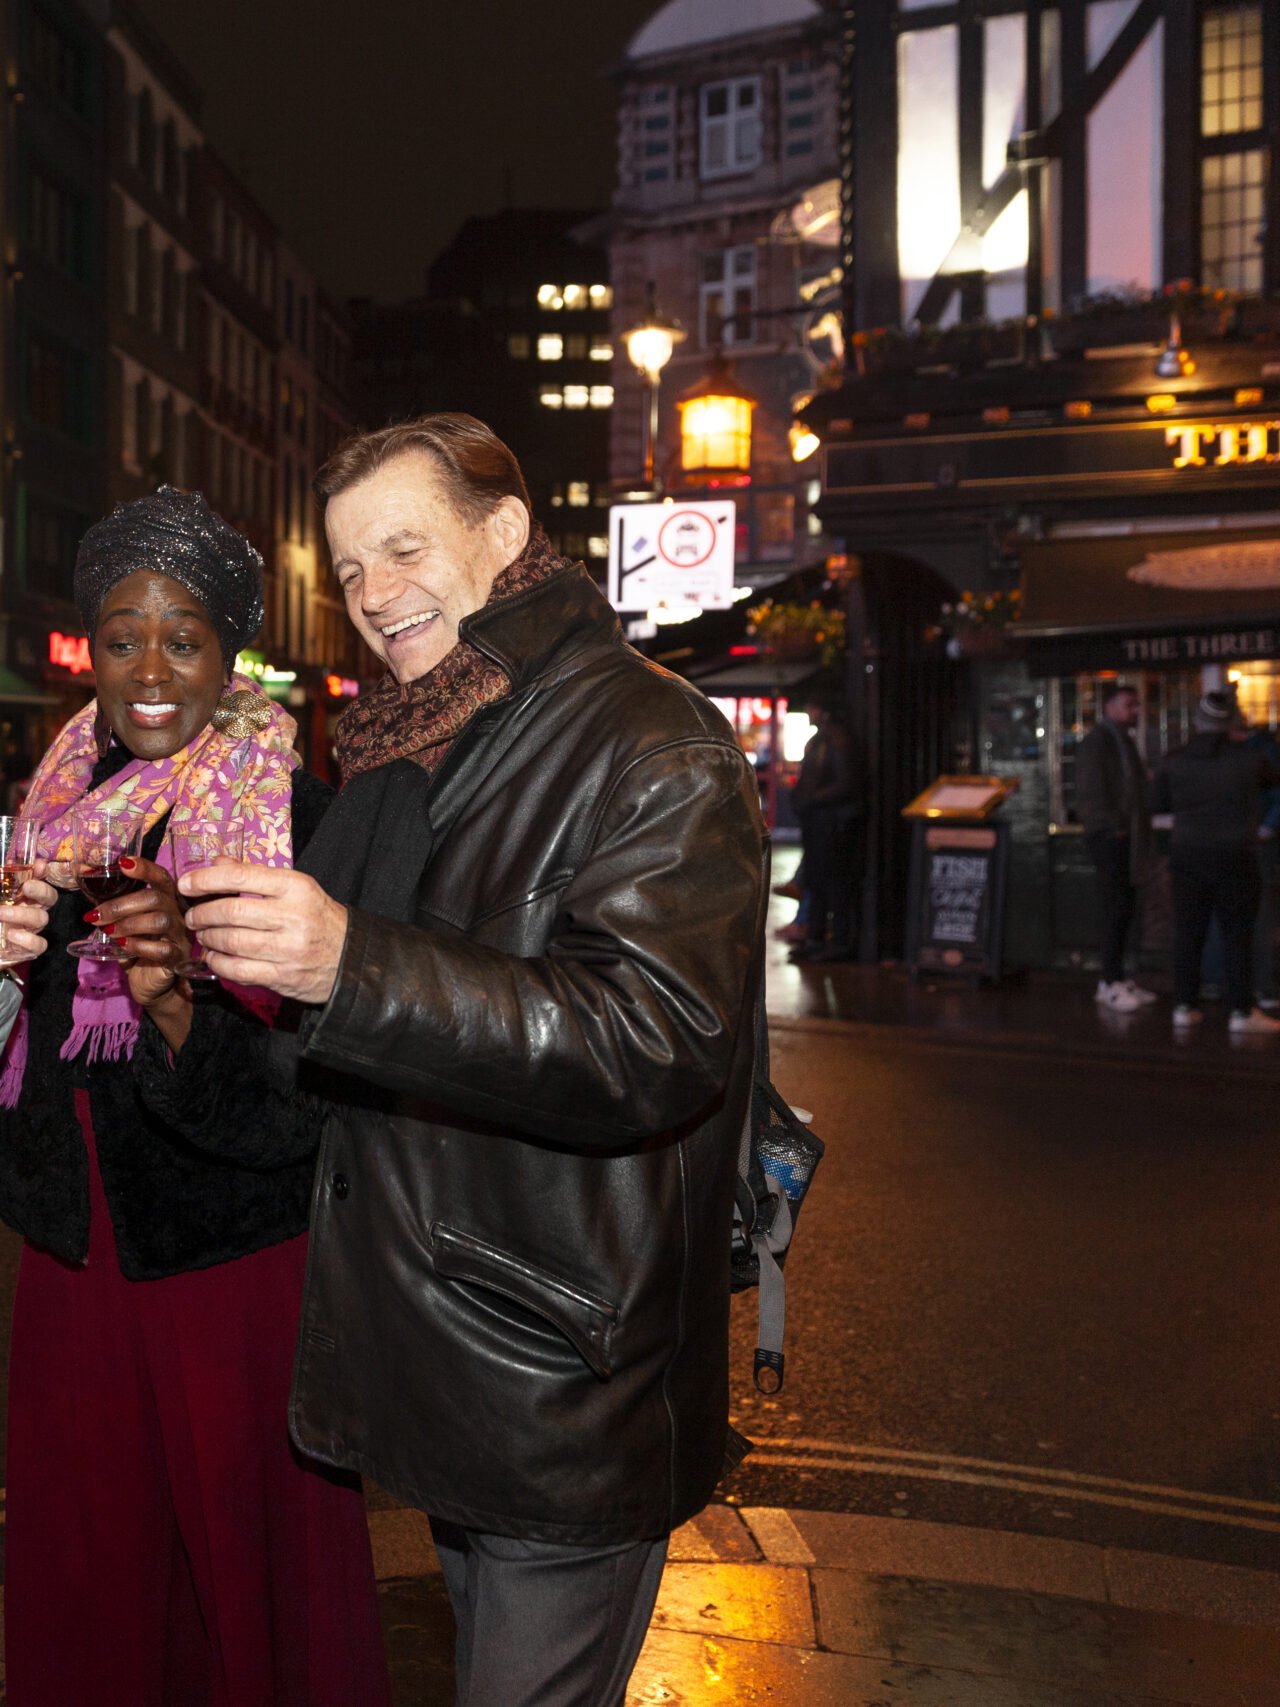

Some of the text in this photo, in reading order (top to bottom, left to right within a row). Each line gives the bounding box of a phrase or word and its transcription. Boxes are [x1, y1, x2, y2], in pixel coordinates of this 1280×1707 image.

[1165, 424, 1280, 468] TH
[1125, 631, 1273, 660] THE THREE
[931, 856, 988, 880] FISH
